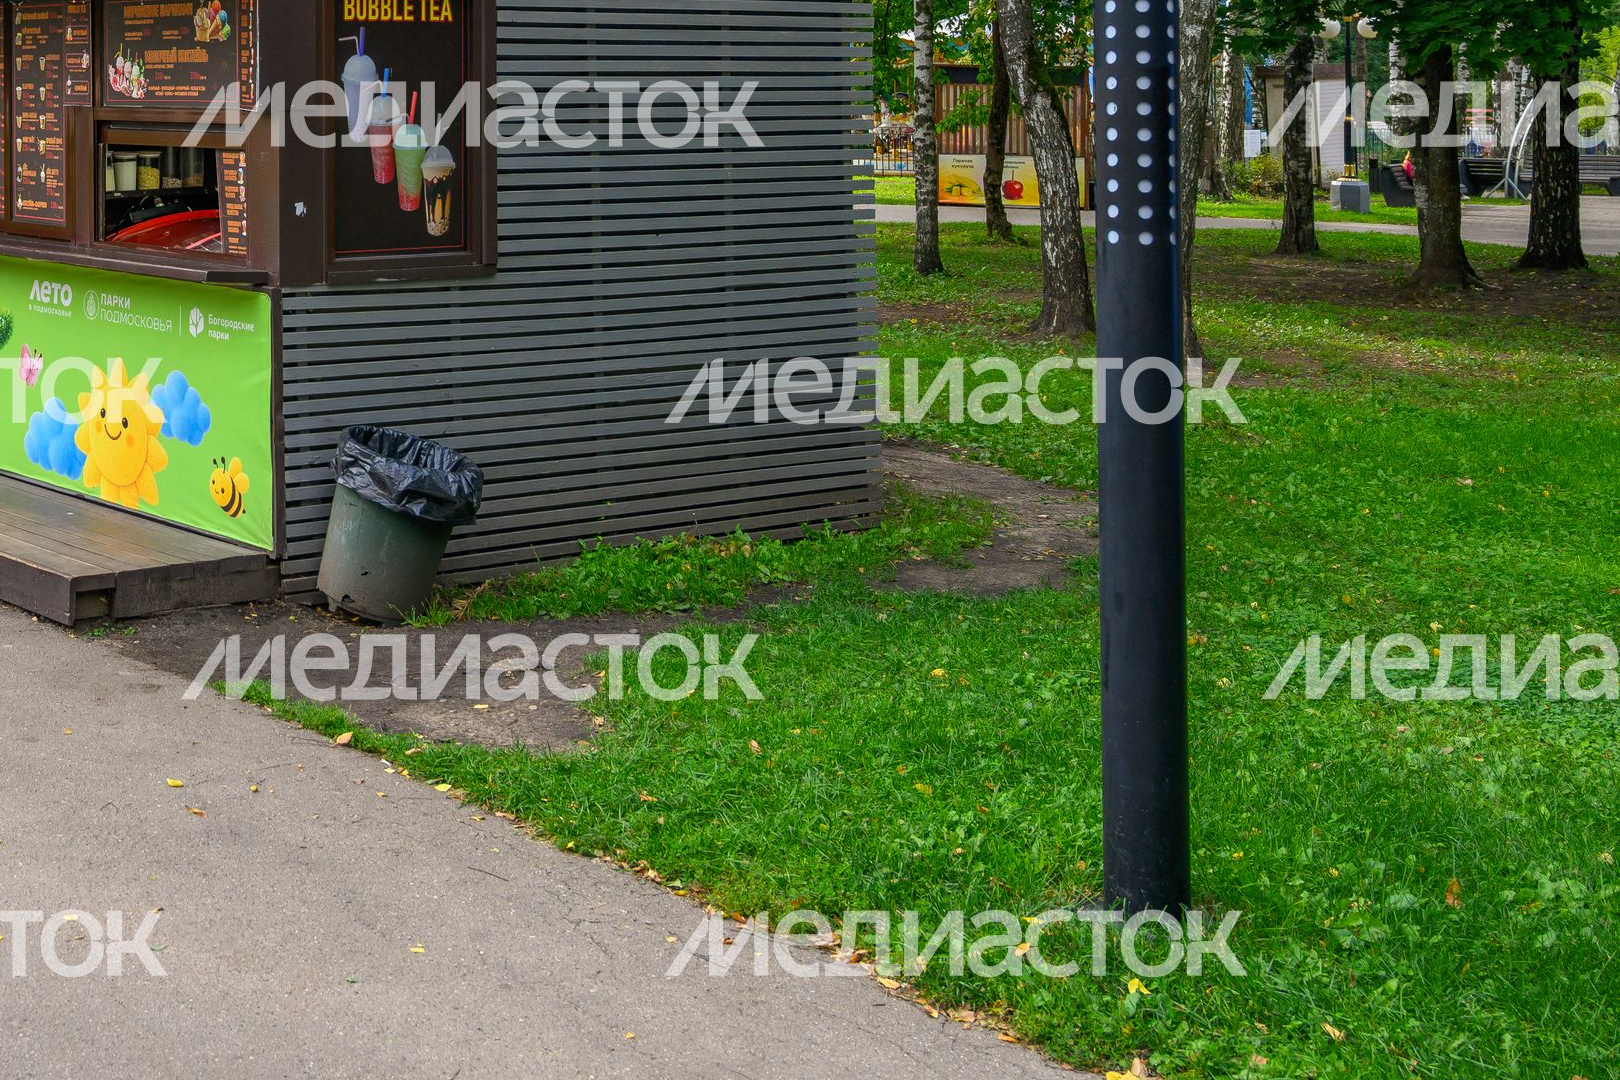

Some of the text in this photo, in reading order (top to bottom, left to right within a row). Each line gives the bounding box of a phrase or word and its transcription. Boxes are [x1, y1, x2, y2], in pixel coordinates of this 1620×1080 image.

[100, 293, 131, 308] ПАРКИ
[100, 308, 173, 333] ПОДМОСКОВЬЯ
[208, 313, 255, 332] Богородские
[208, 329, 230, 341] парки
